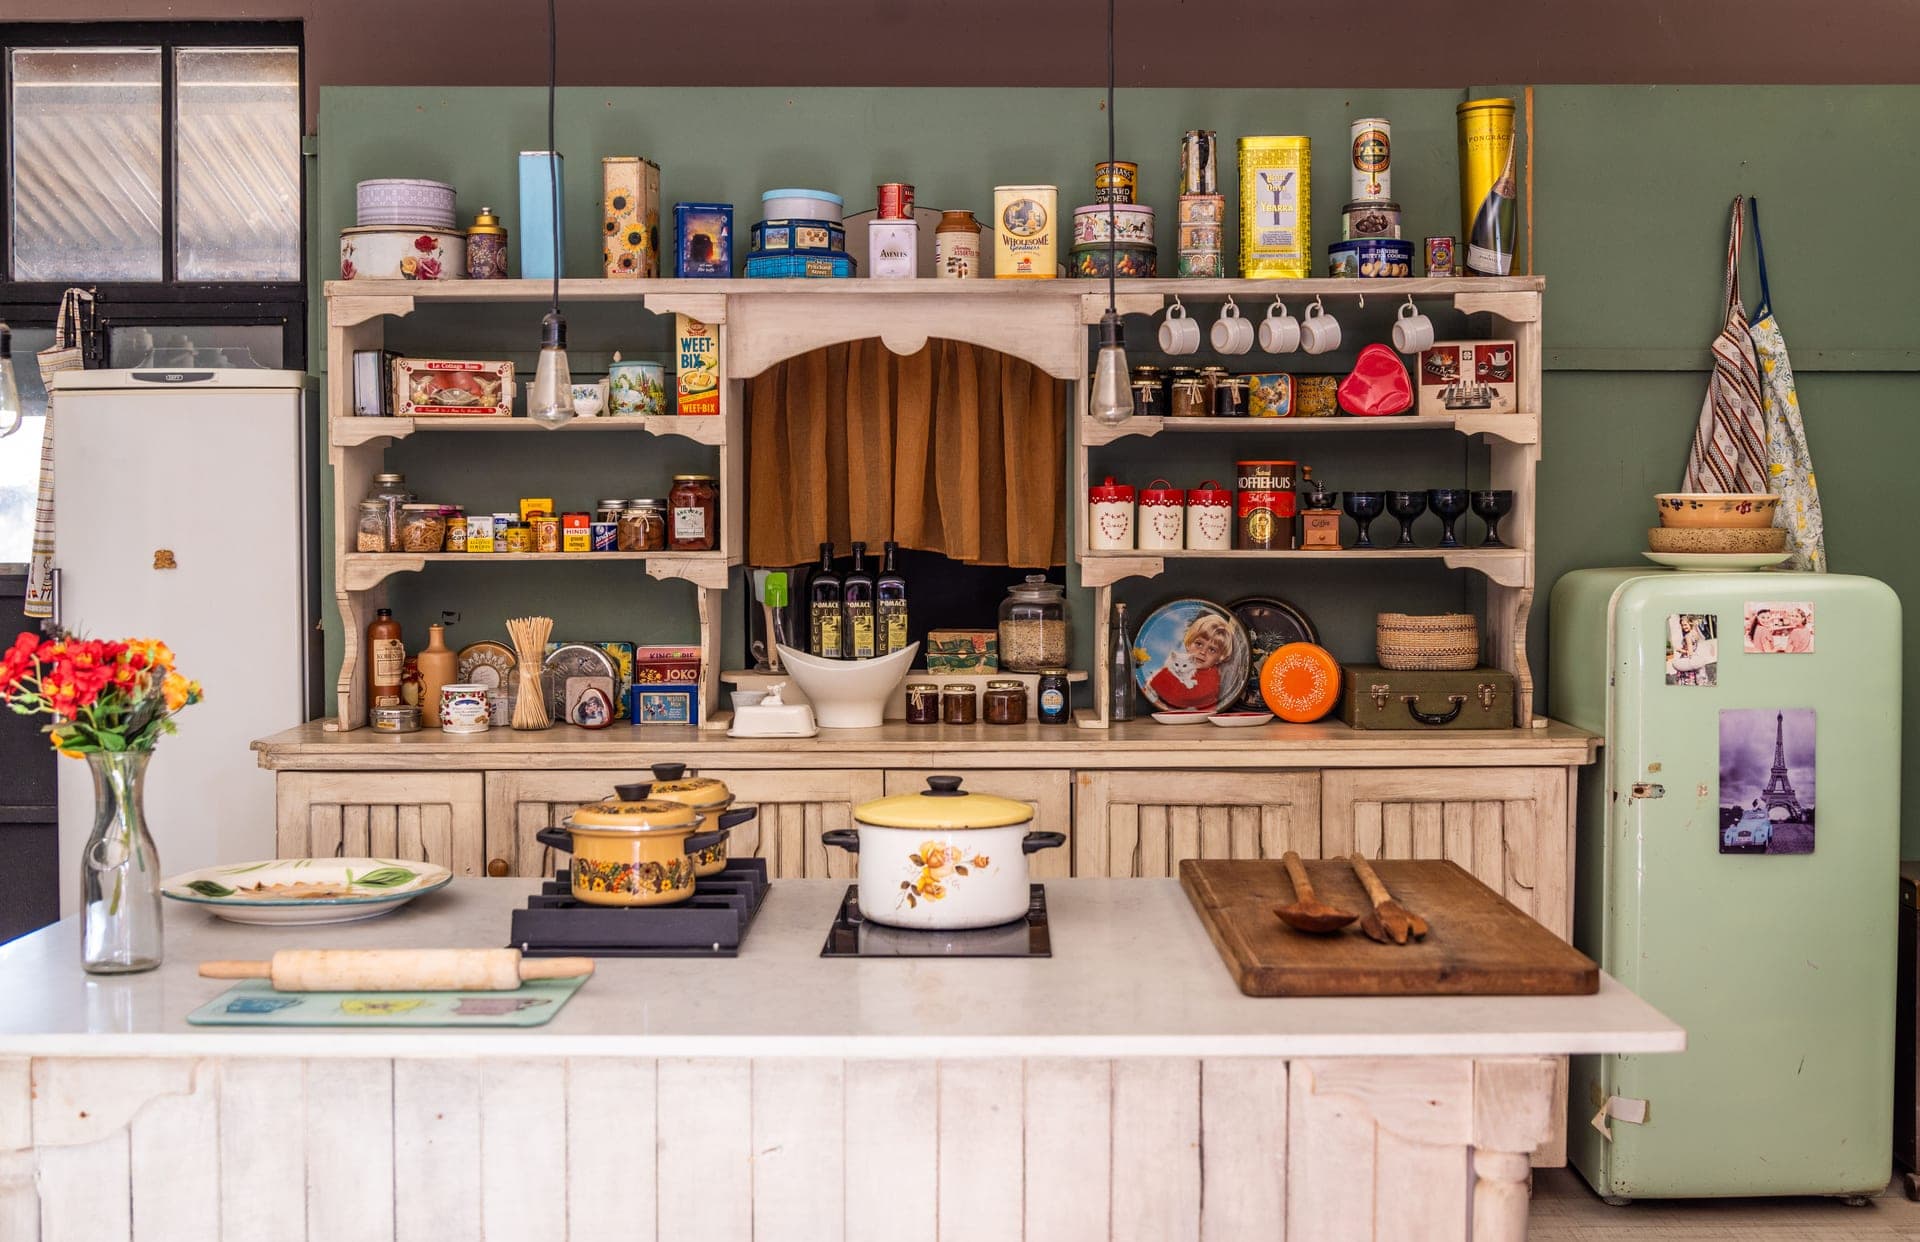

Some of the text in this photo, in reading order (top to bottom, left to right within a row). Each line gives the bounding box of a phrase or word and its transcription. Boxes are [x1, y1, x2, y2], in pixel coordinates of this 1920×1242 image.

[1002, 234, 1049, 246] WHOLESOME
[681, 337, 715, 353] WEET-
[681, 353, 701, 368] BIX
[682, 403, 715, 413] WEET-BIX
[664, 669, 697, 682] JOKO
